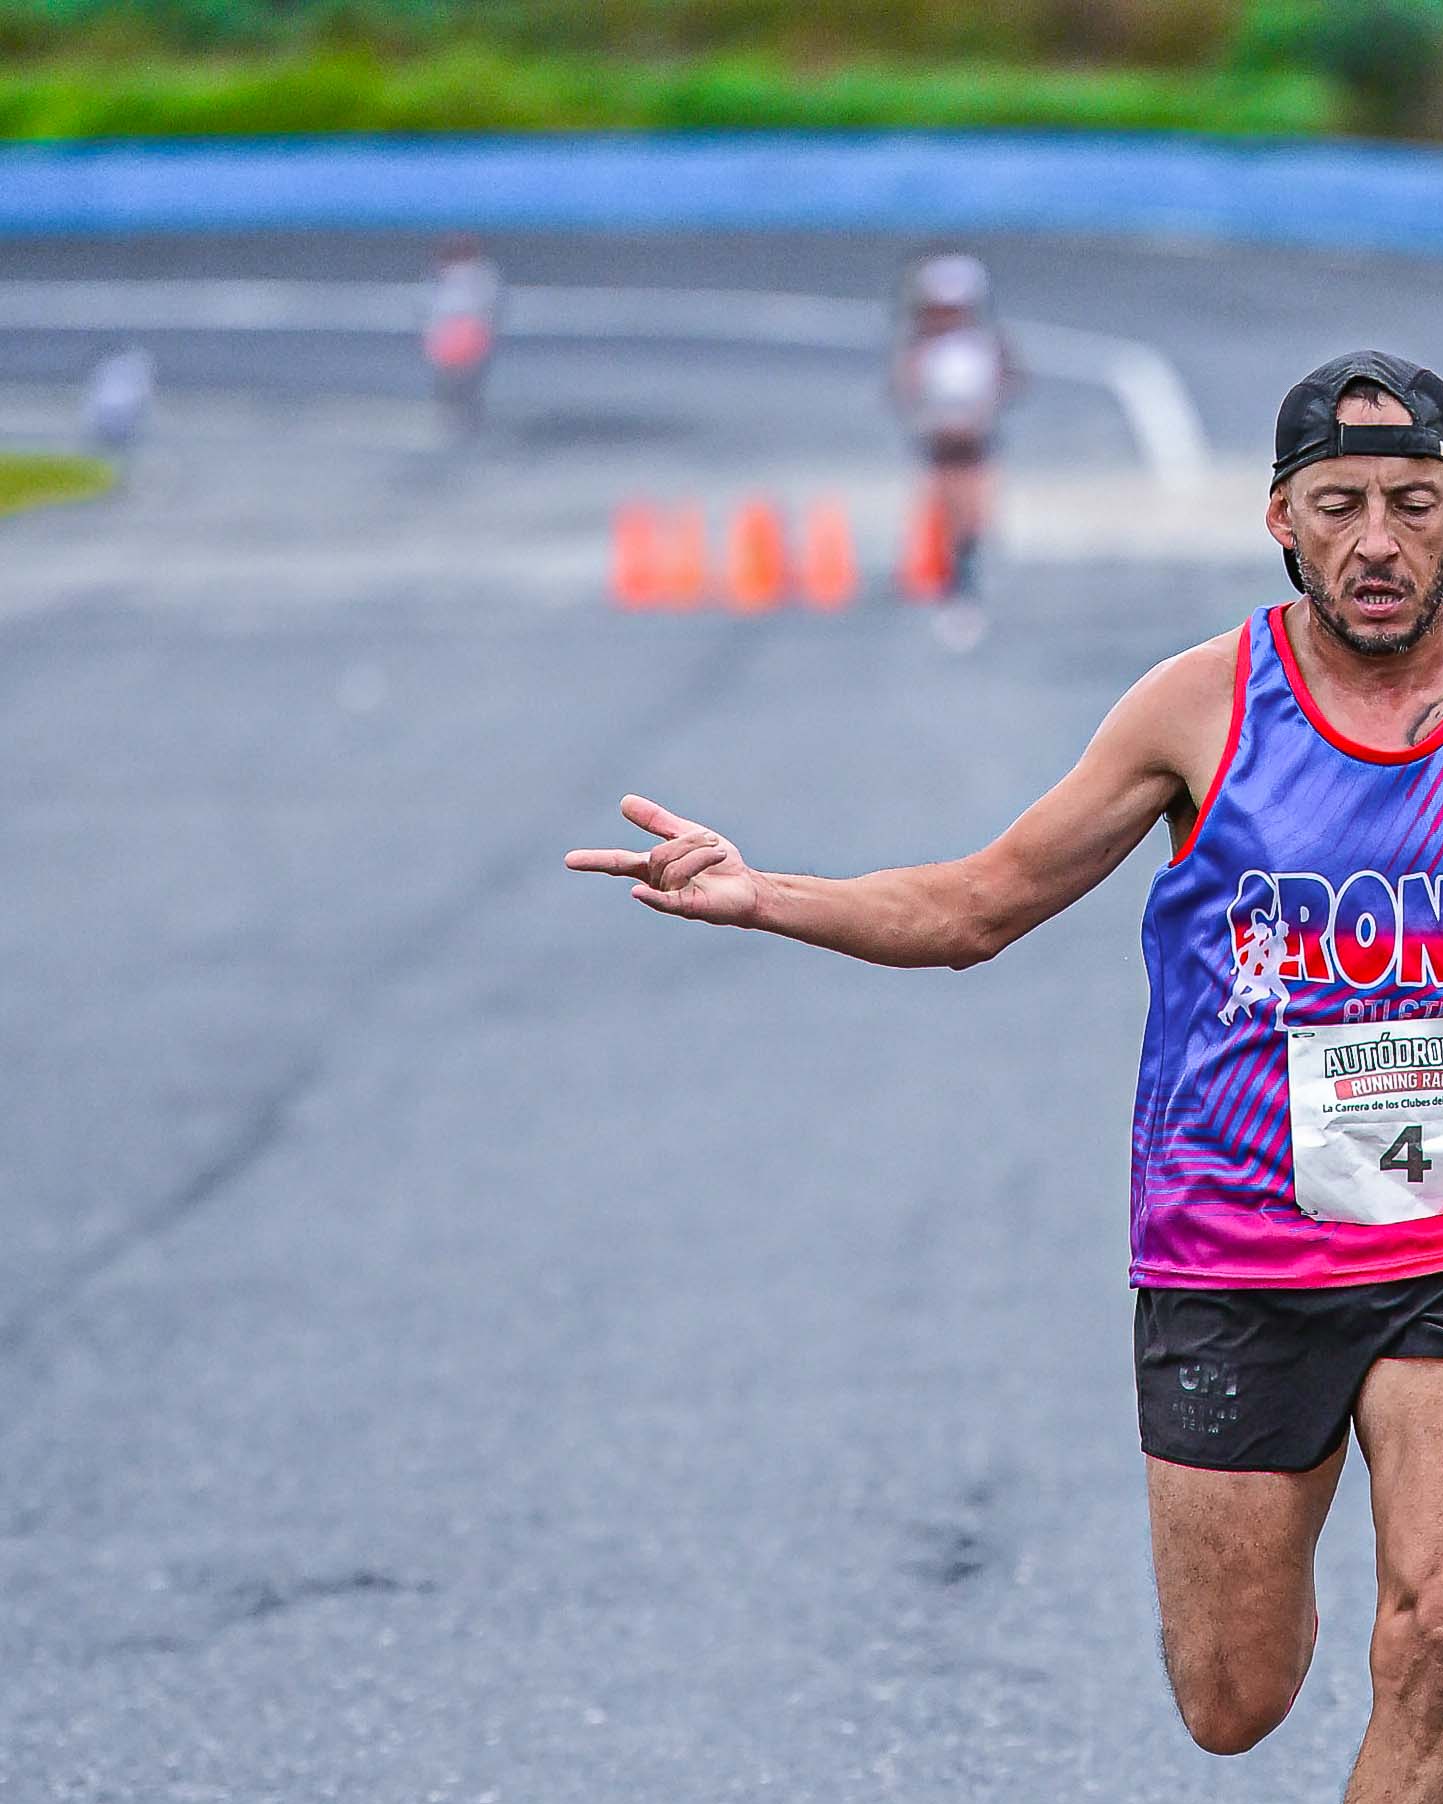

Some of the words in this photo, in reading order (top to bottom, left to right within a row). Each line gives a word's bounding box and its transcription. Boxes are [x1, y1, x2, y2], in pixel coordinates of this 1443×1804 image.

[1350, 1073, 1417, 1097] RUNNING
[1322, 1104, 1333, 1113] La
[1335, 1102, 1370, 1113] Carrera
[1371, 1100, 1384, 1110] de
[1385, 1099, 1399, 1110] los
[1401, 1098, 1431, 1108] Clubes
[1379, 1125, 1432, 1183] 4
